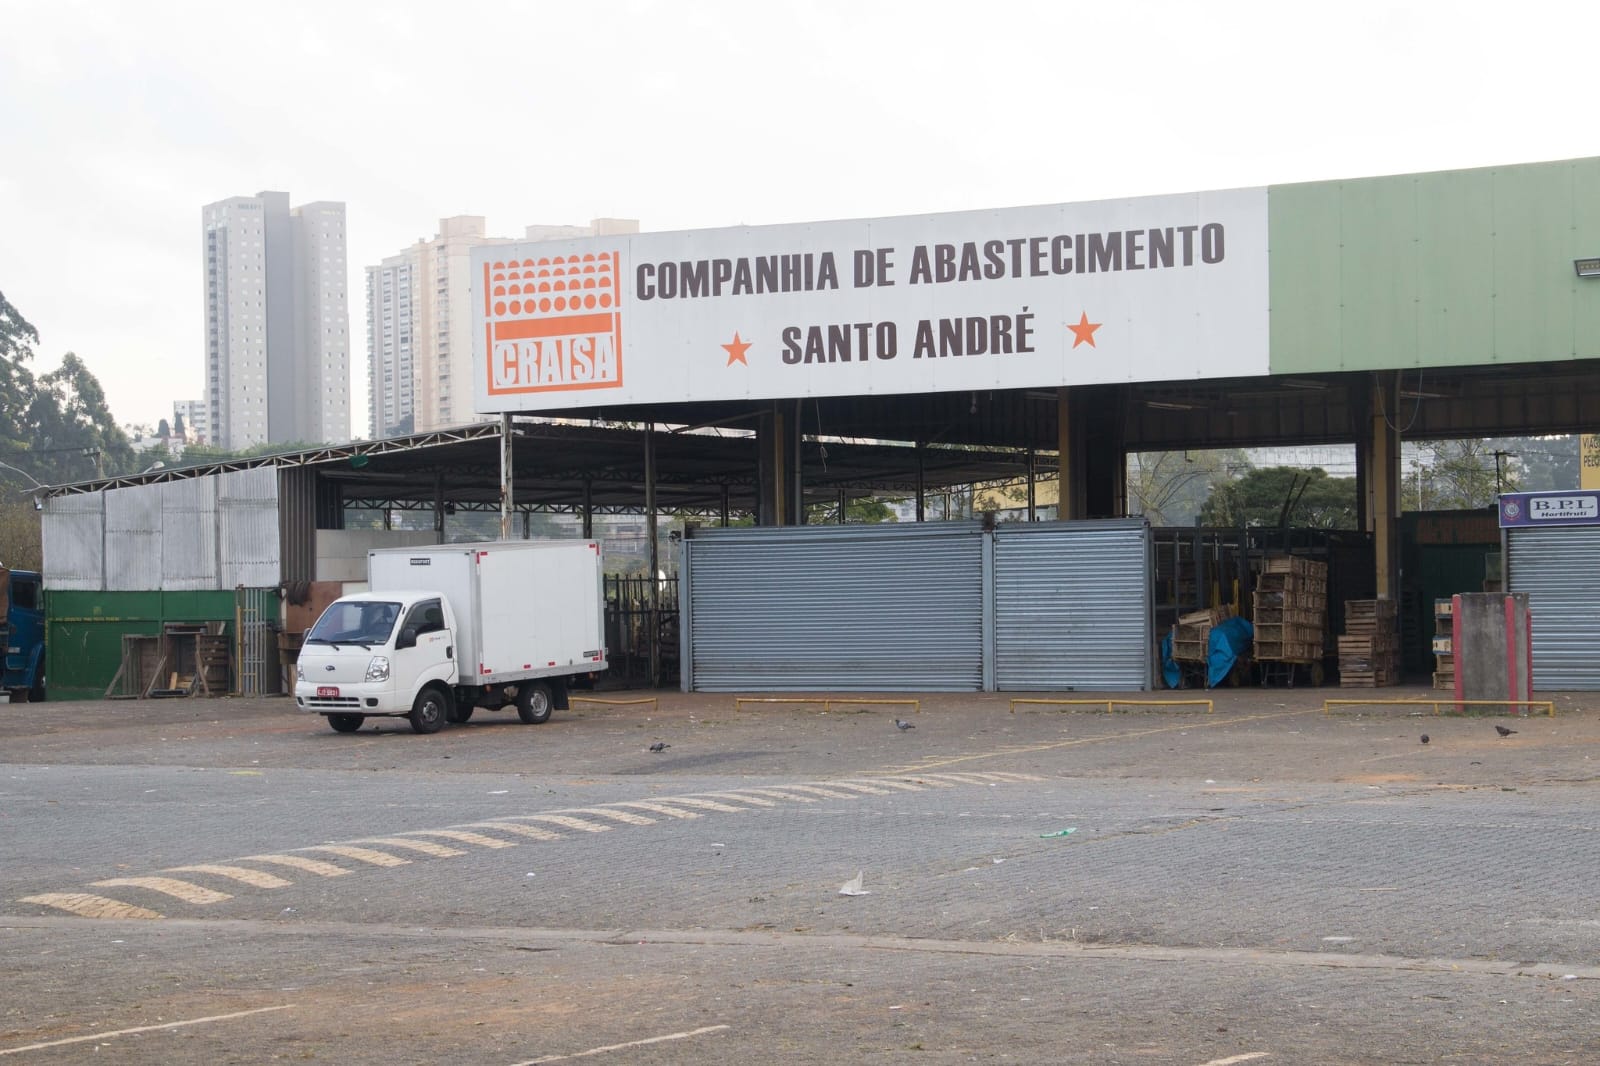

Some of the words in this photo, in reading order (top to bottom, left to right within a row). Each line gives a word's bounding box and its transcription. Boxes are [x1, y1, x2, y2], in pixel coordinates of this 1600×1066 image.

[637, 252, 839, 301] COMPANHIA
[854, 247, 895, 289] DE
[909, 223, 1225, 284] ABASTECIMENTO
[495, 336, 613, 386] CRAISA
[782, 321, 898, 365] SANTO
[913, 306, 1035, 359] ANDRÉ
